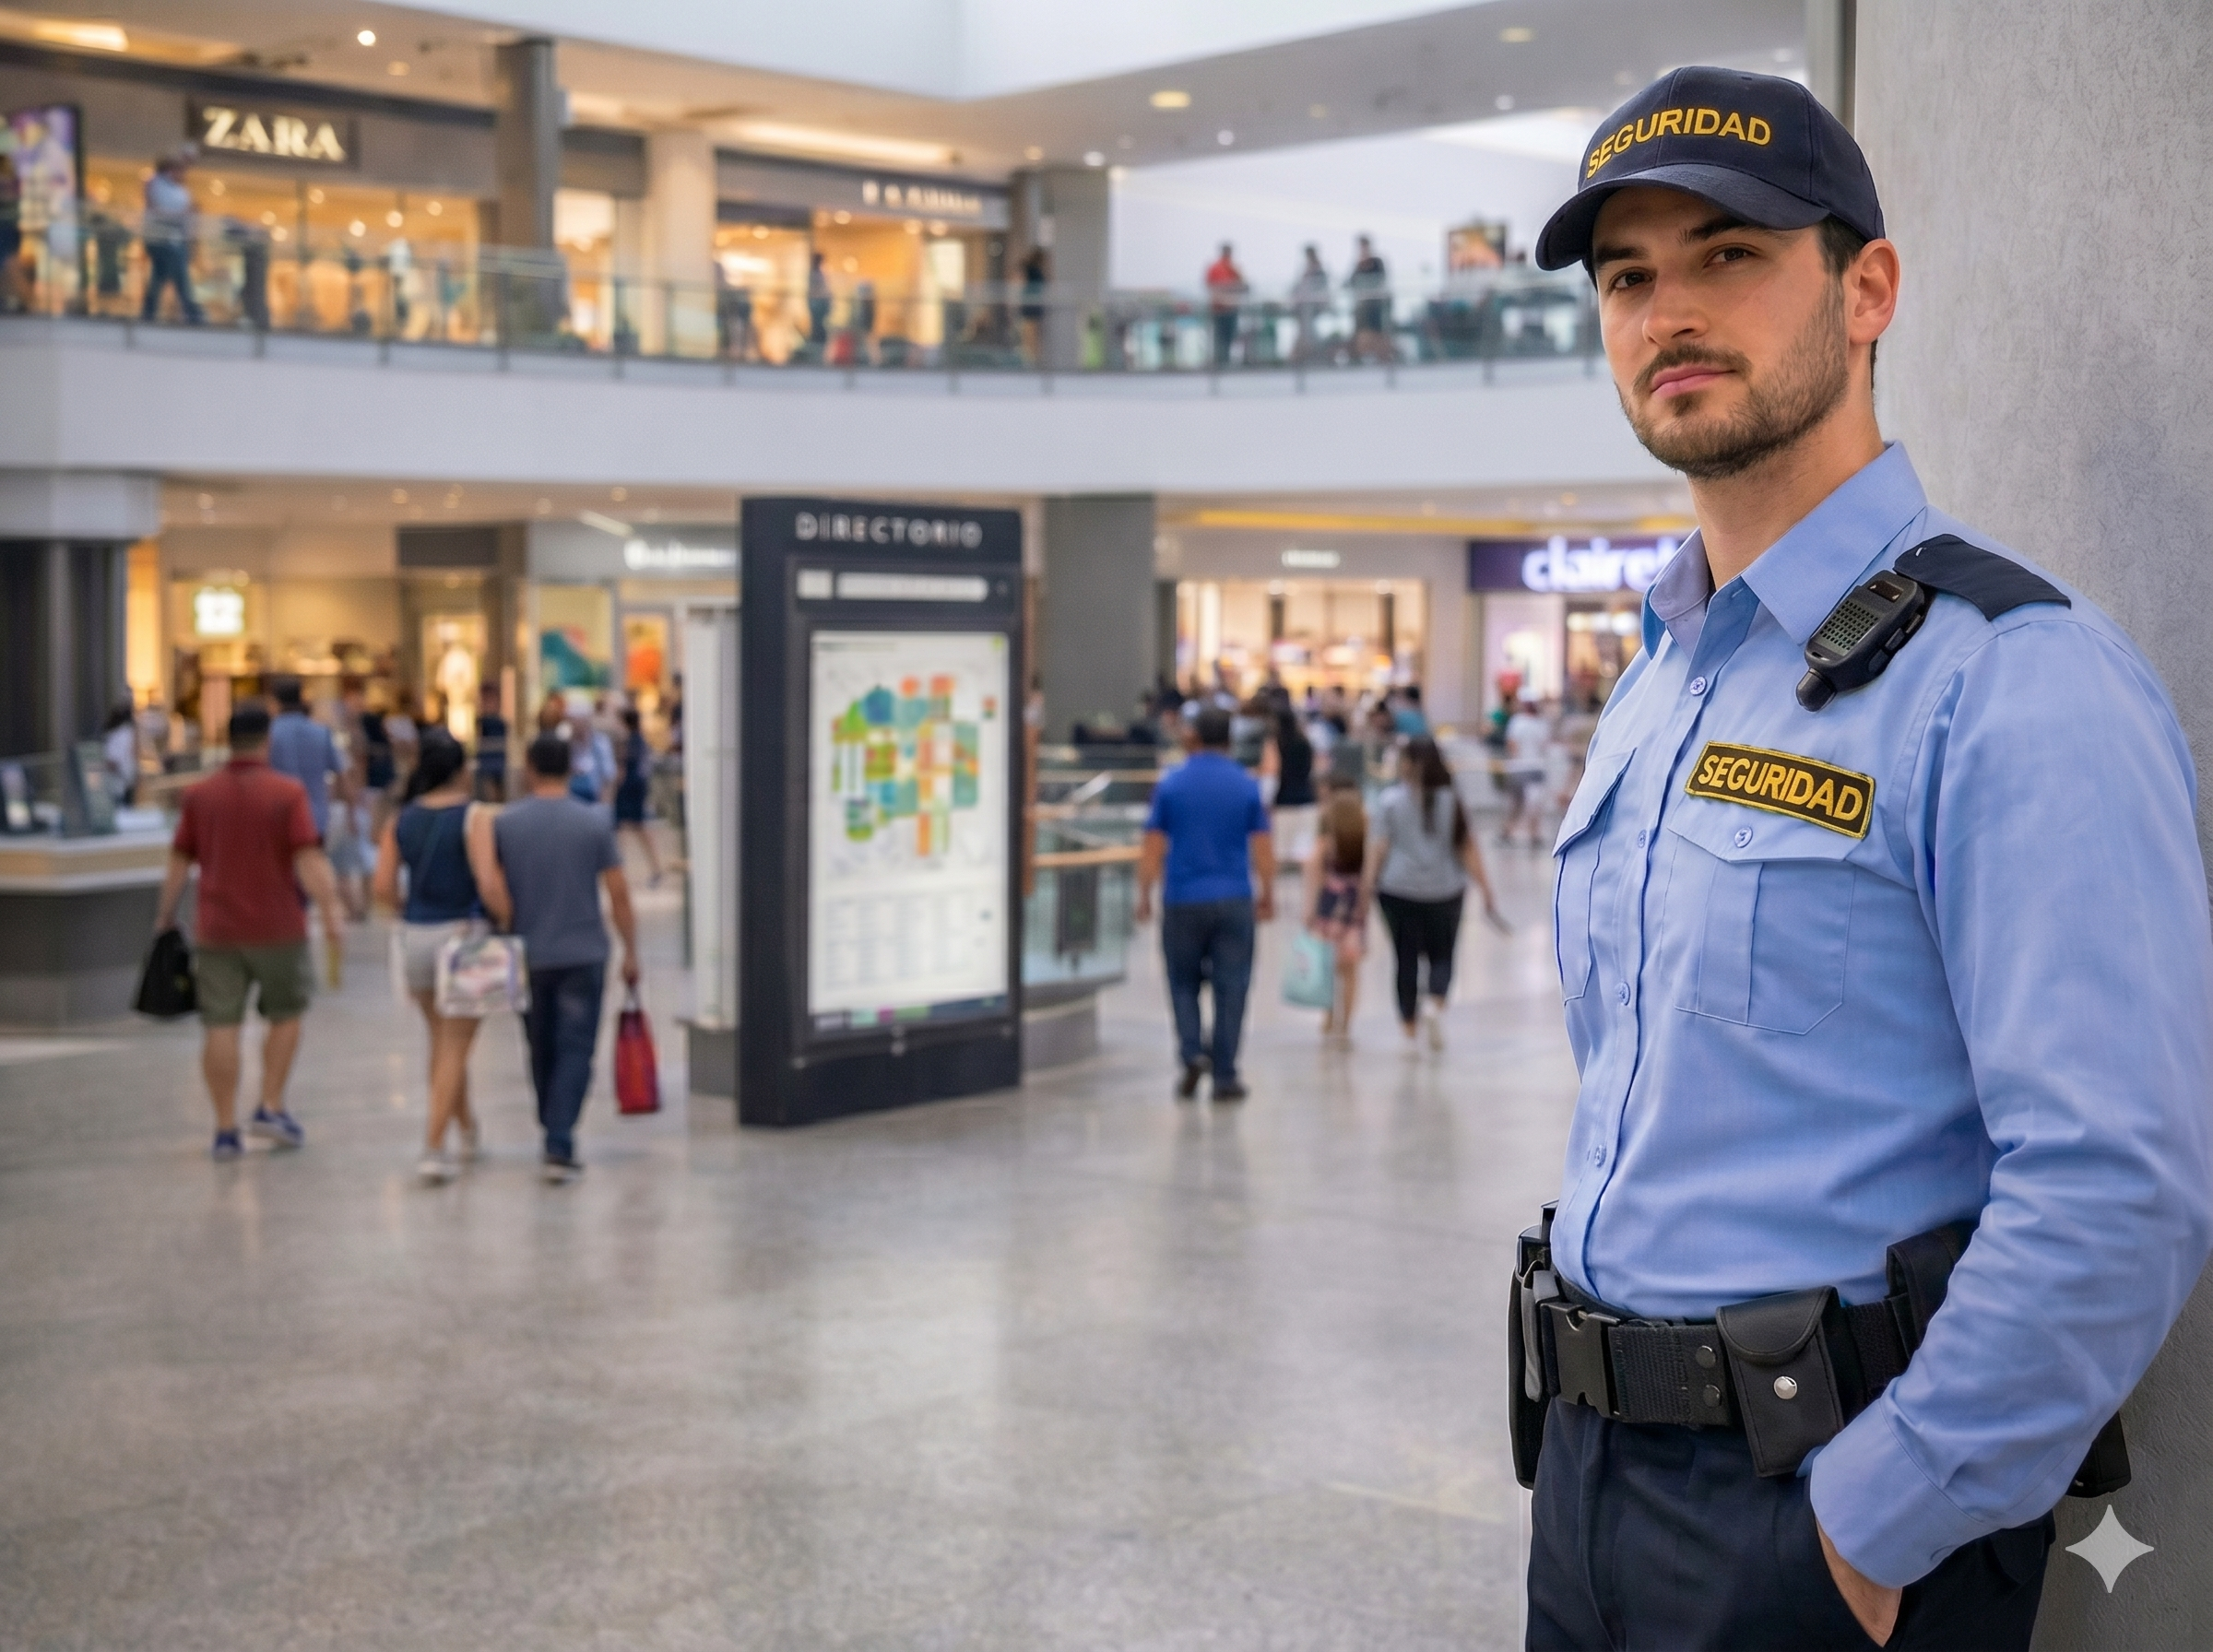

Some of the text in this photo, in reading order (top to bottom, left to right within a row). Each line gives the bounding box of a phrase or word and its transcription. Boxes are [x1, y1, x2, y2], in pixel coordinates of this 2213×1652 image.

[203, 106, 347, 163] ZARA
[1586, 108, 1771, 179] SEGURIDAD
[795, 511, 984, 549] DIRECTORIO
[1698, 754, 1864, 821] SEGURIDAD
